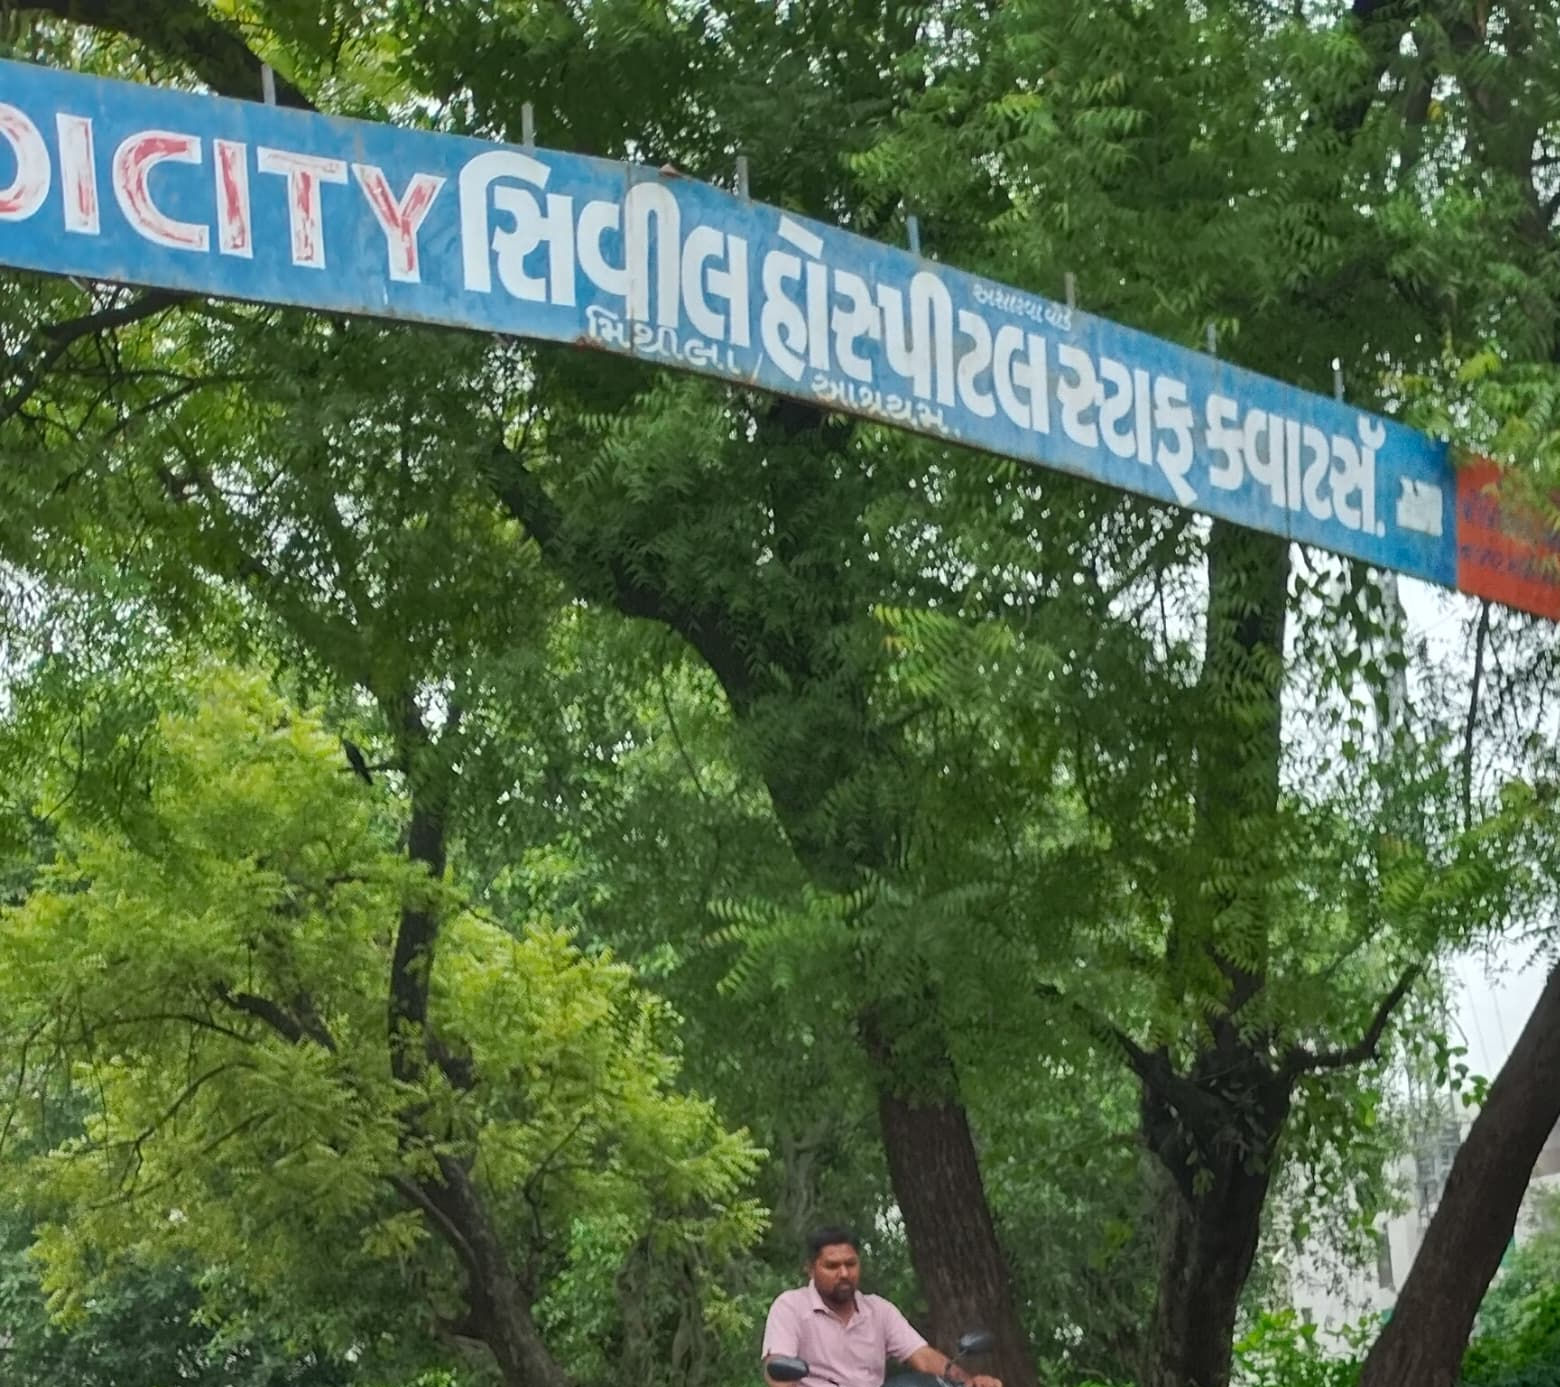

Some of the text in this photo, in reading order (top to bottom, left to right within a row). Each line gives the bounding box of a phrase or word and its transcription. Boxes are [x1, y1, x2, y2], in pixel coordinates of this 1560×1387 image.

[459, 150, 751, 347] સિવીલ
[760, 214, 1049, 434] હોસ્પીટલ
[1057, 343, 1197, 504] સ્ટાફ
